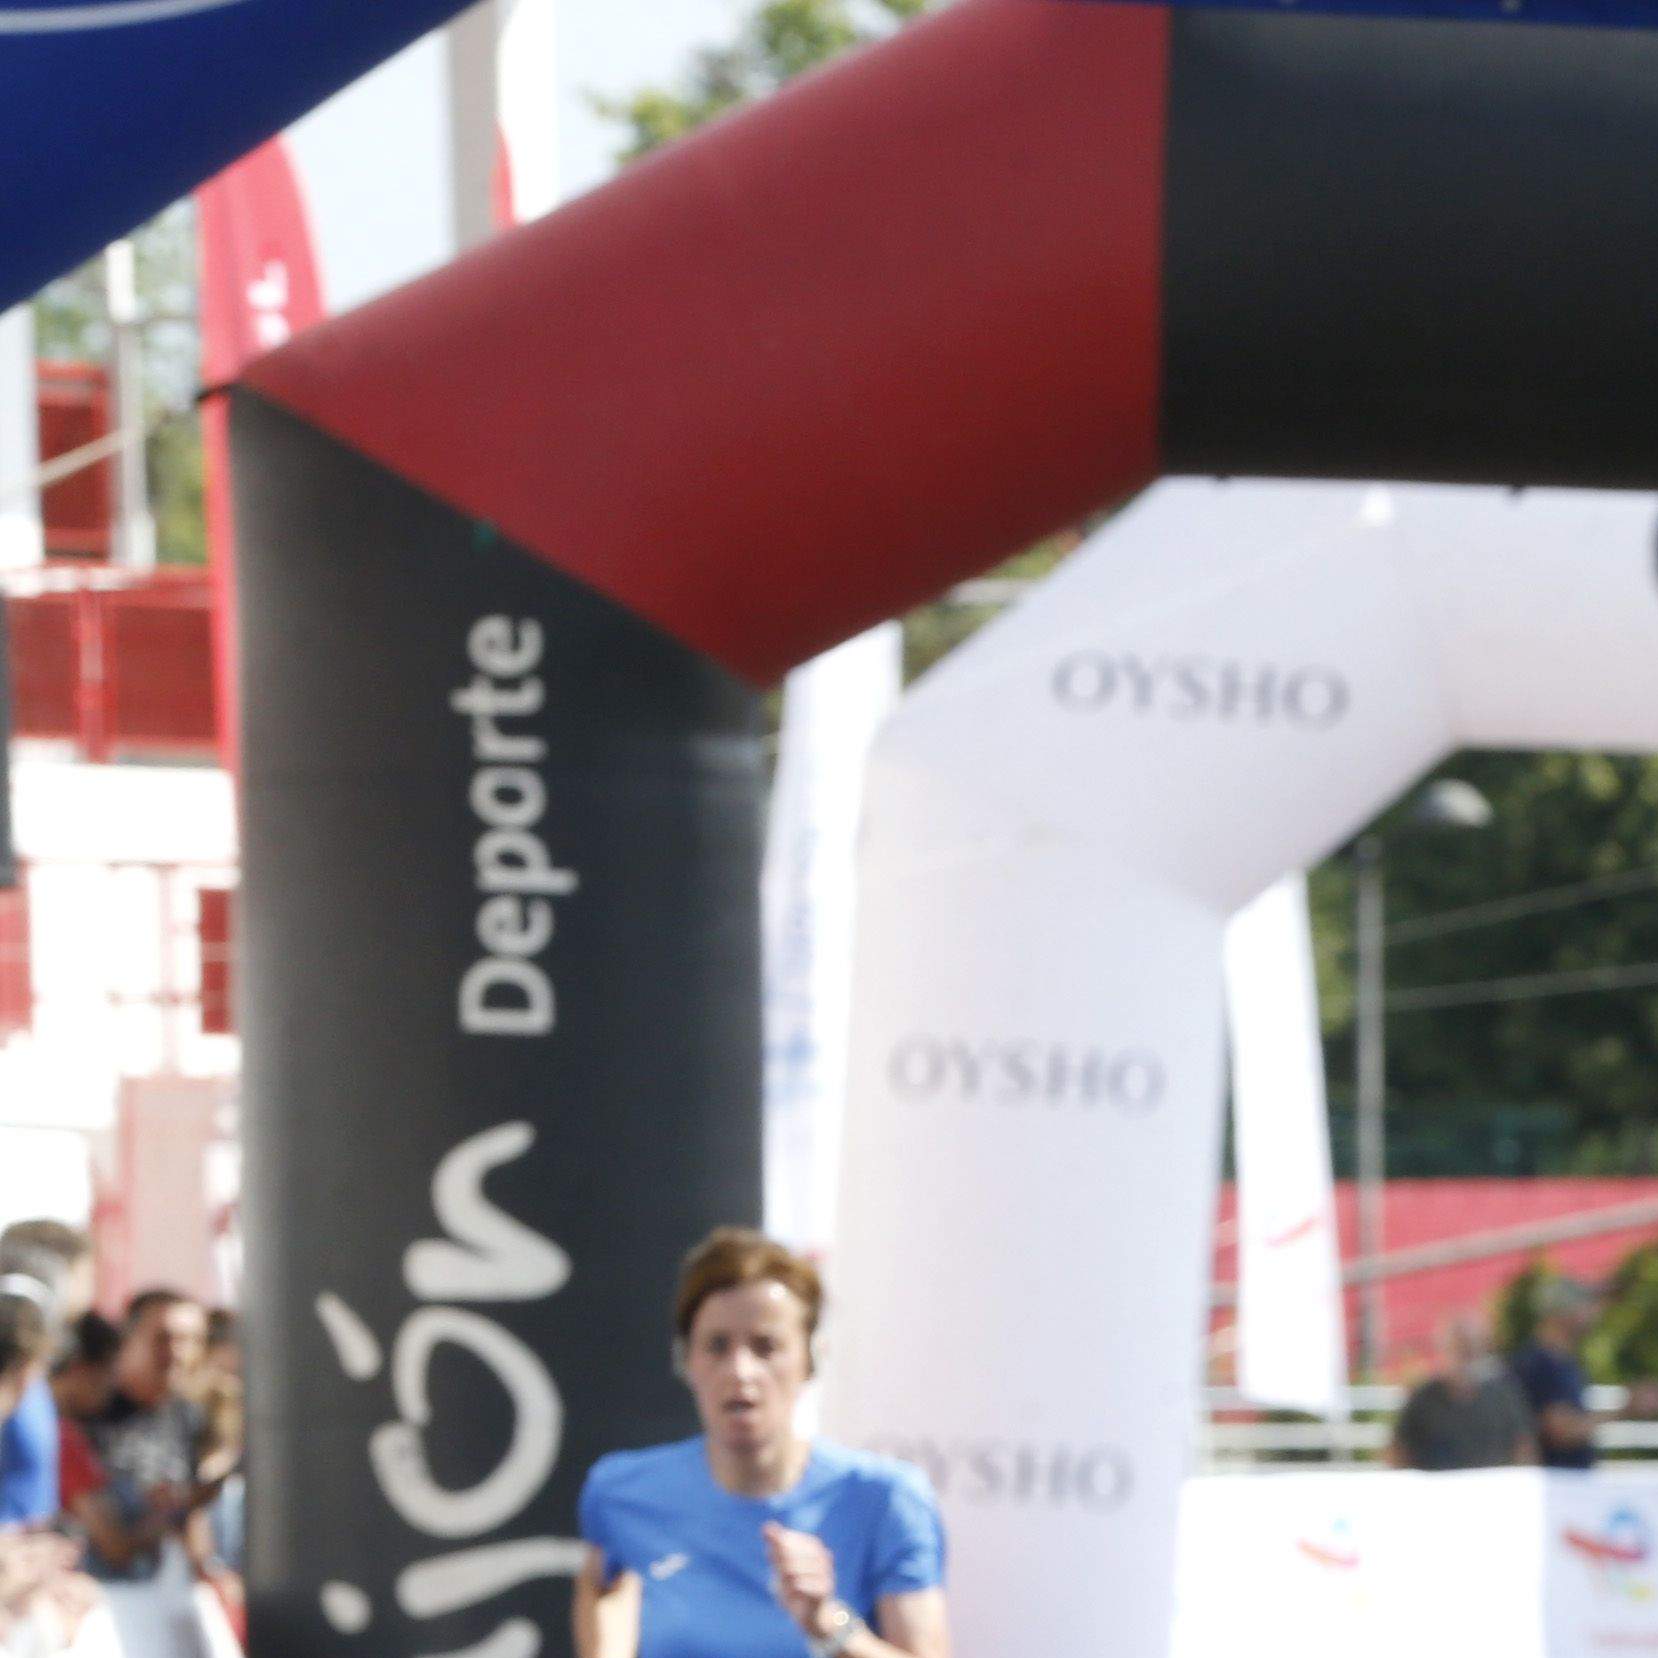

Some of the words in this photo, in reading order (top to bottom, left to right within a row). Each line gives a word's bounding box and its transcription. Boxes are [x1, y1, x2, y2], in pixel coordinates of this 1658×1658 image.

[1050, 648, 1352, 732] OYSHO
[449, 612, 580, 1038] Deporte
[888, 1034, 1168, 1117] OYSHO
